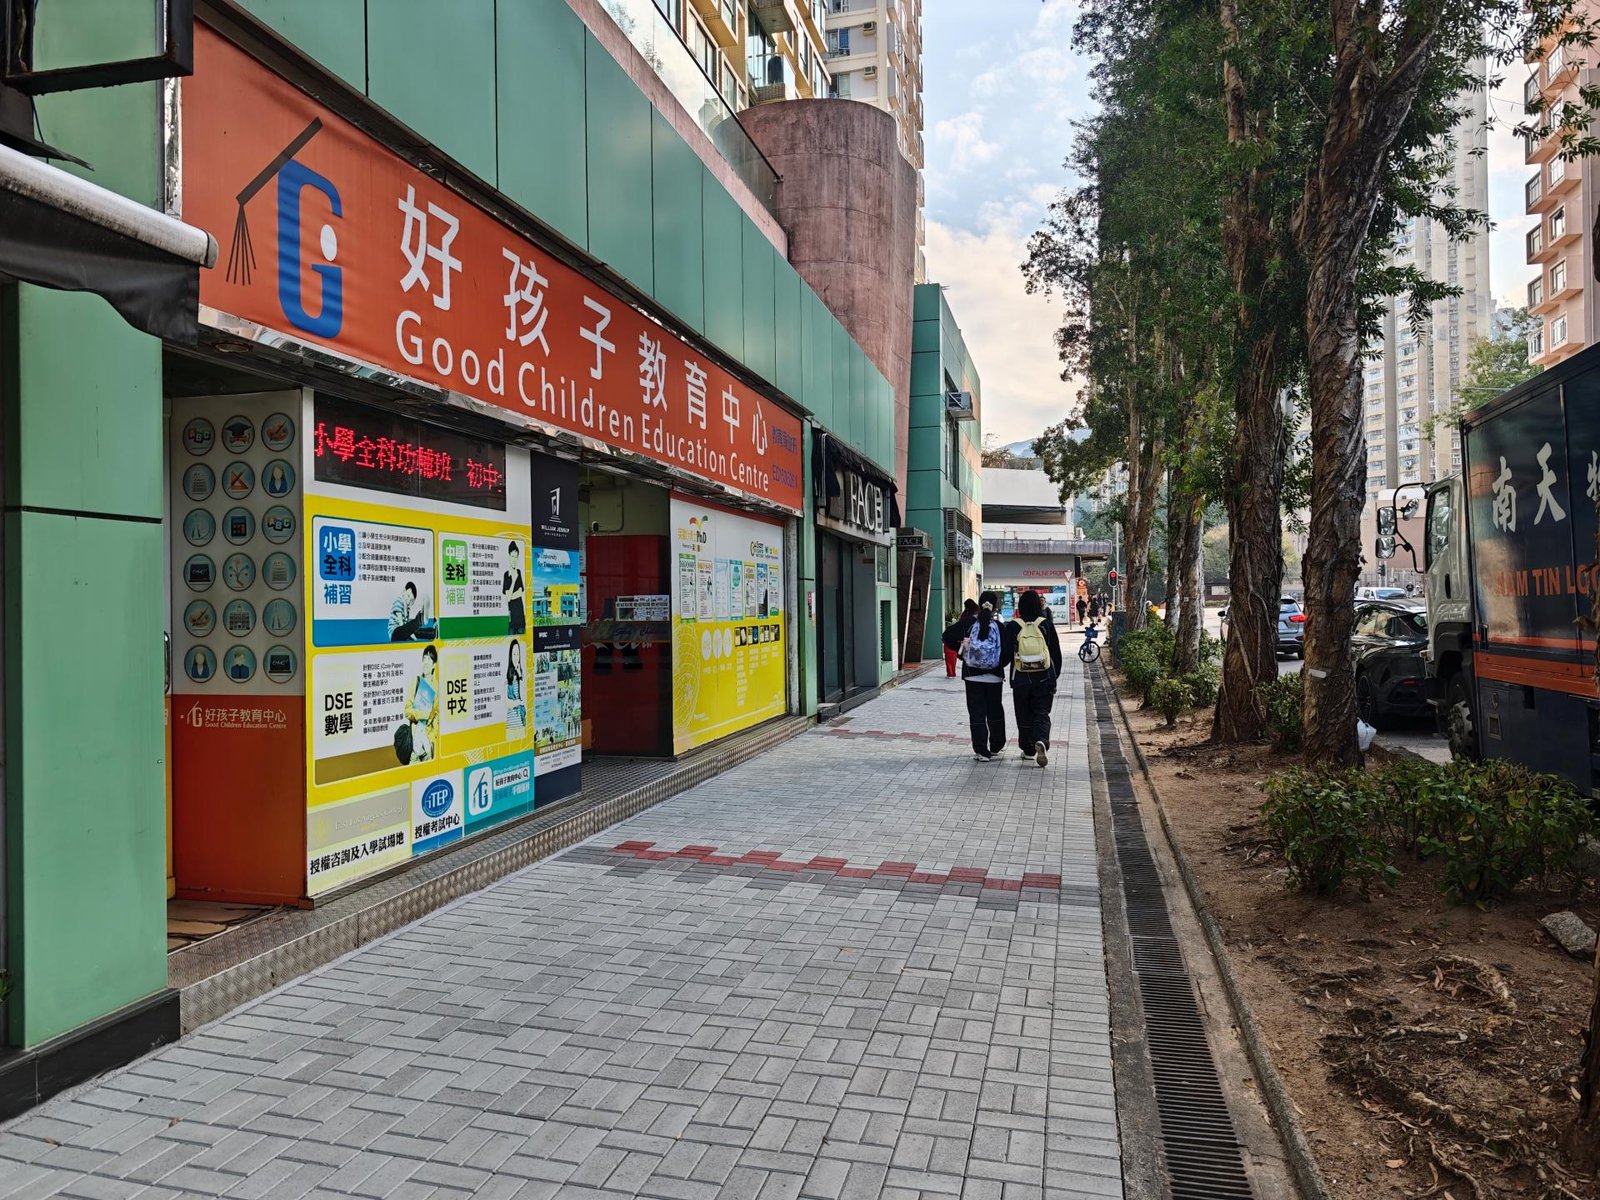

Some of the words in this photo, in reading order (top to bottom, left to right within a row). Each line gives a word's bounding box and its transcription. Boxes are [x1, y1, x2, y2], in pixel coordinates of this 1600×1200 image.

[397, 183, 770, 458] 好孩子教育中心
[394, 309, 507, 398] Good
[516, 362, 636, 445] Children
[640, 412, 727, 475] Education
[728, 453, 771, 494] Centre
[849, 472, 885, 535] FACE
[323, 531, 353, 555] 小學
[897, 536, 923, 546] FACE
[445, 543, 466, 563] 中學
[323, 555, 352, 577] 全科
[445, 562, 466, 582] 全科
[1495, 570, 1529, 598] NAM
[1531, 566, 1562, 597] TIN
[323, 583, 352, 606] 補習
[446, 586, 466, 607] 補習
[446, 678, 467, 696] DSE
[324, 691, 353, 713] DSE
[447, 696, 467, 716] 中文
[204, 708, 287, 723] 好孩子教育中心
[220, 721, 242, 729] Children
[324, 714, 353, 737] 數學
[427, 788, 449, 810] iTEP
[414, 812, 461, 840] 授權考試中心
[309, 831, 405, 876] 授權咨詢及入學試場地
